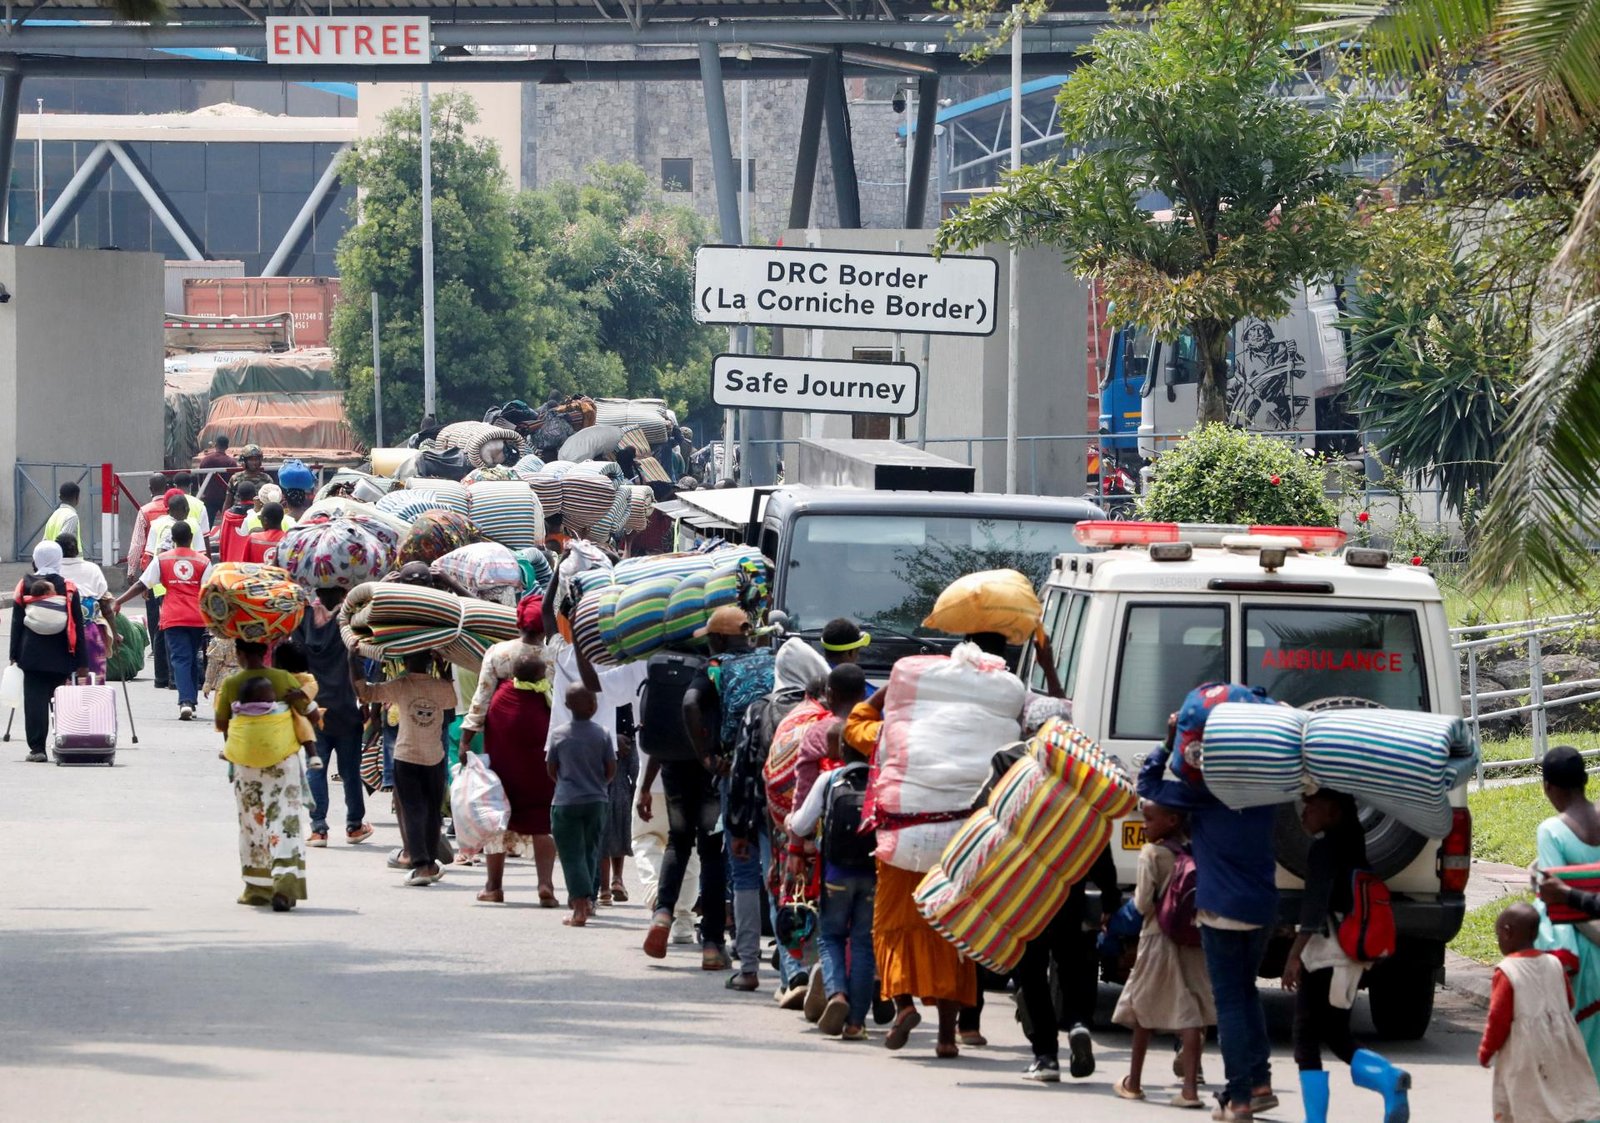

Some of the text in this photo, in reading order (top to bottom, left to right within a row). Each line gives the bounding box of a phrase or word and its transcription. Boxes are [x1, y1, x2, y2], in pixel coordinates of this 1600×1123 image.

[274, 25, 421, 55] ENTREE
[767, 261, 929, 289] DRC Border
[701, 287, 987, 325] (La Corniche Border)
[725, 369, 906, 404] Safe Journey
[1261, 648, 1403, 672] AMBULANCE
